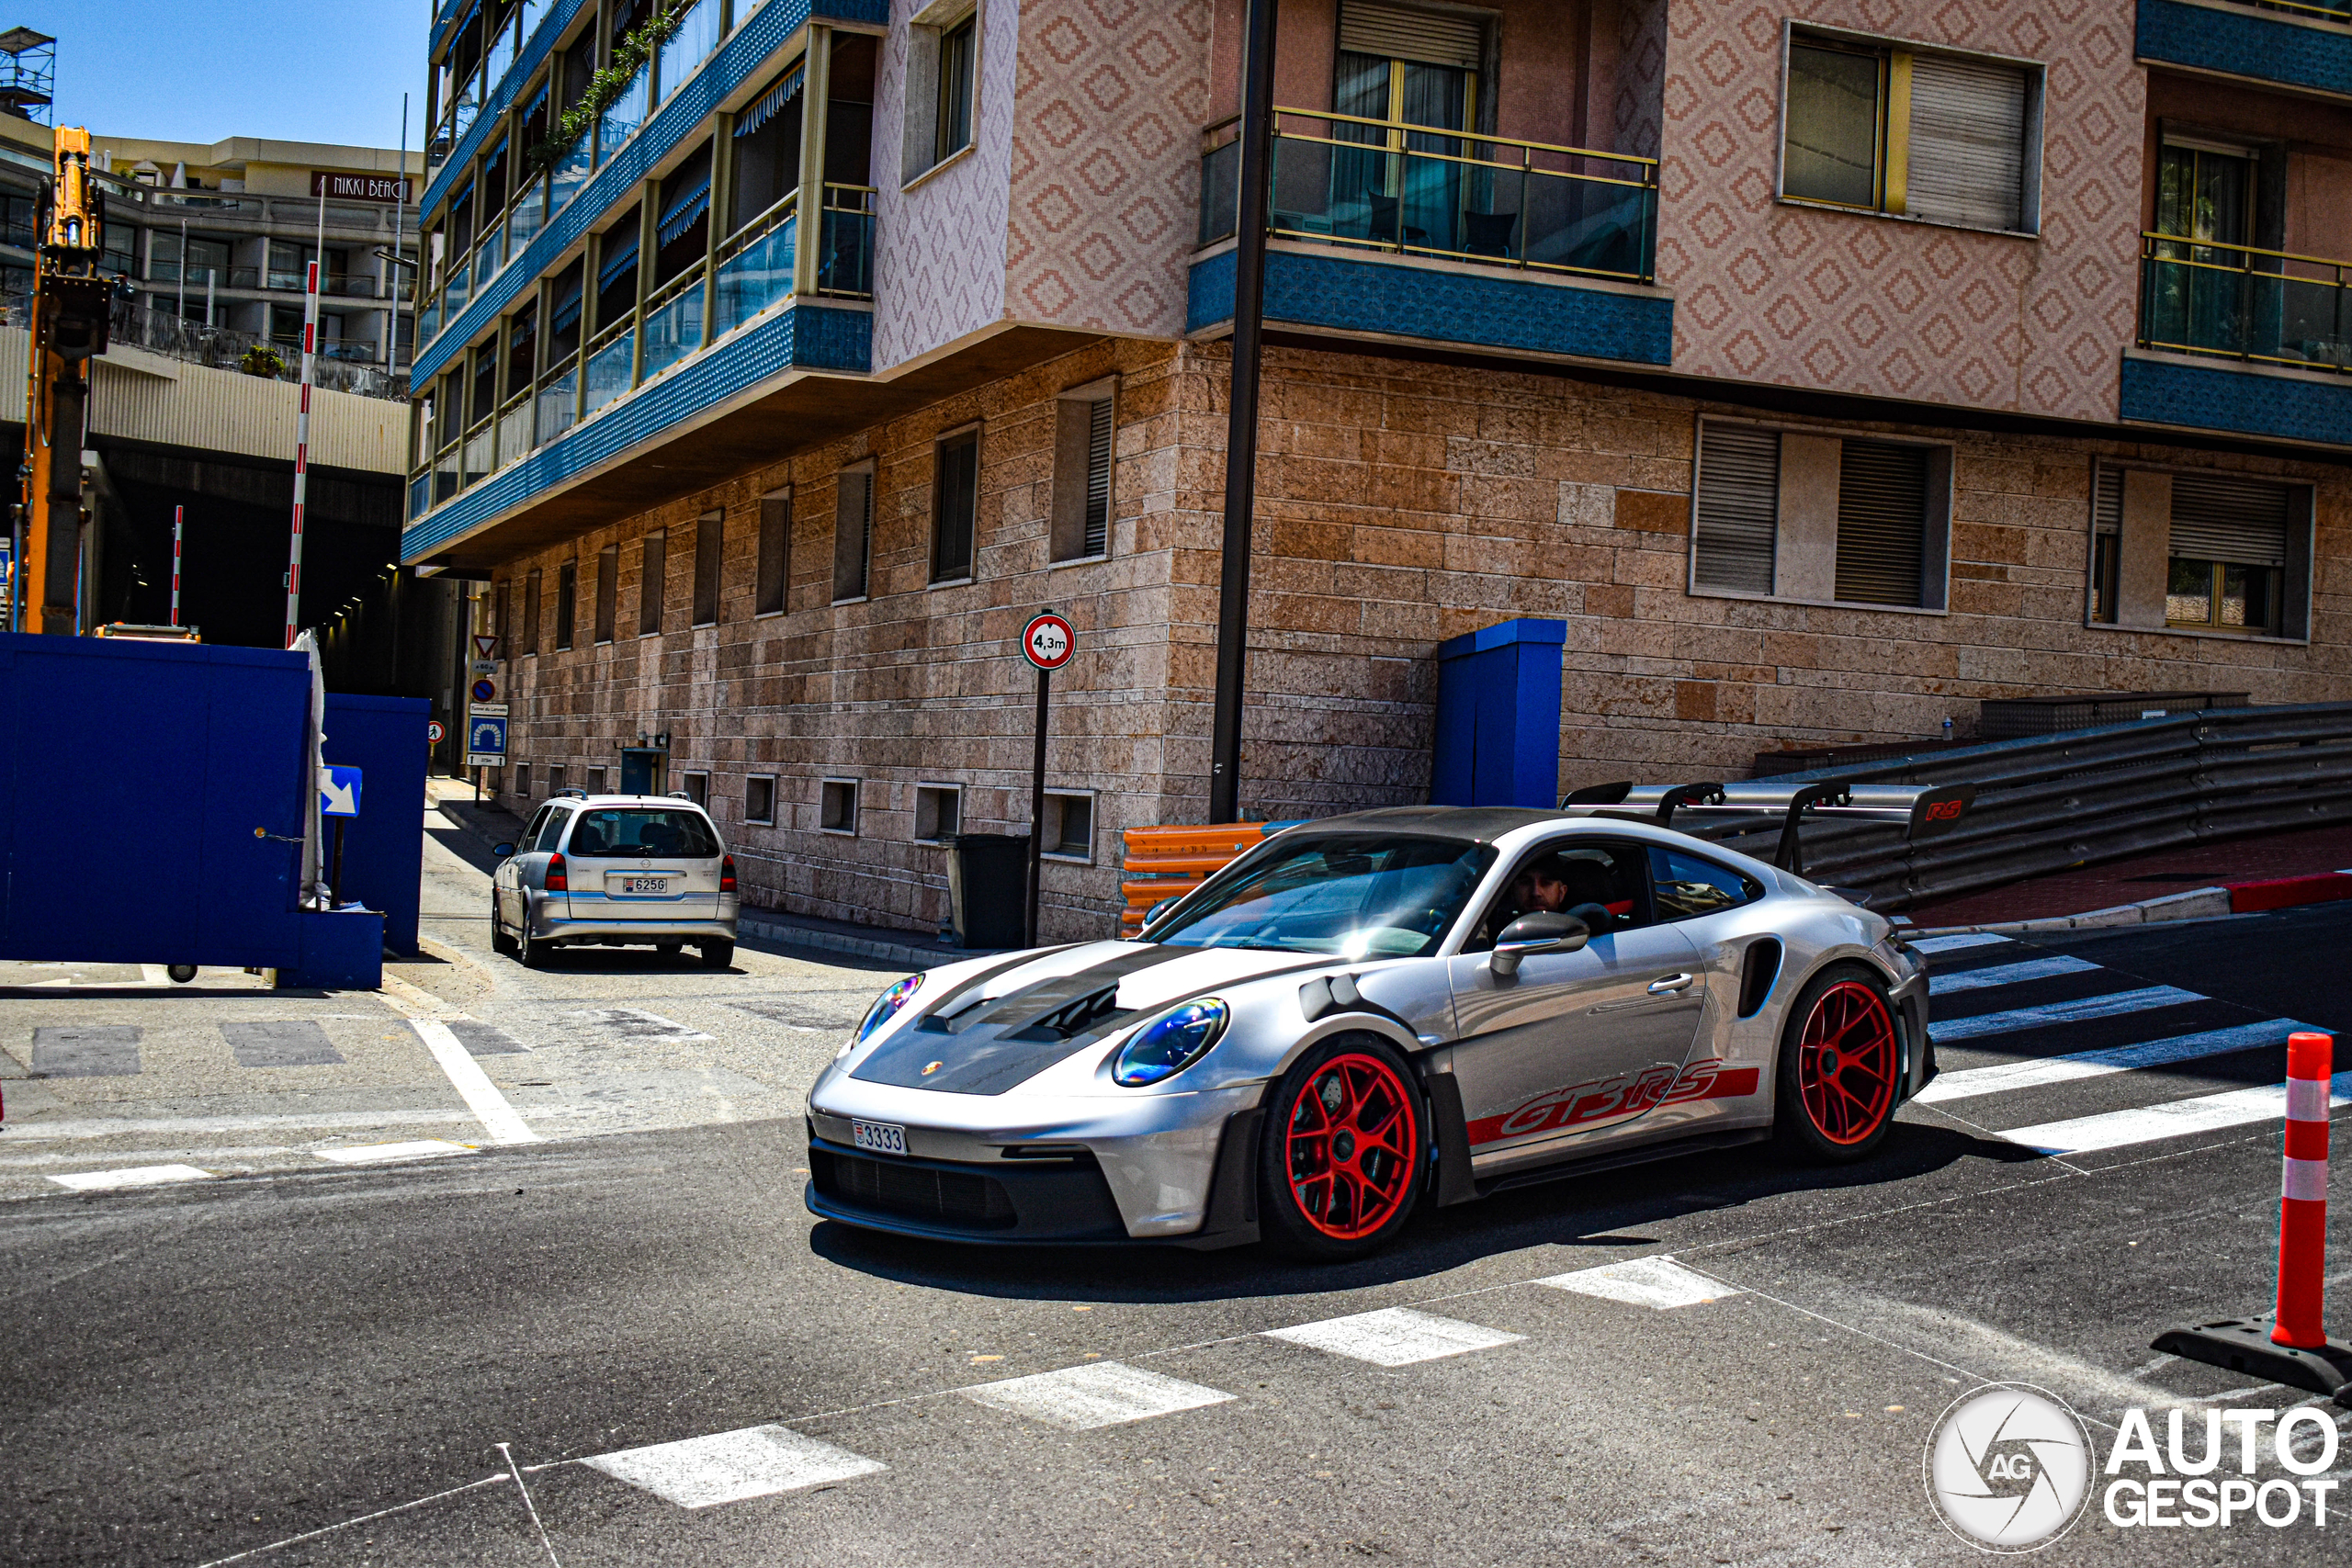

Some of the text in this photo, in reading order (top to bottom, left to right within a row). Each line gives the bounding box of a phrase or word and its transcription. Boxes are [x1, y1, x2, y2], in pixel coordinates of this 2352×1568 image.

[334, 176, 408, 201] NIKKI BEAC
[1034, 634, 1066, 650] 4,3m
[1926, 800, 1962, 821] RS
[636, 879, 665, 890] 625G
[865, 1125, 902, 1151] 3333
